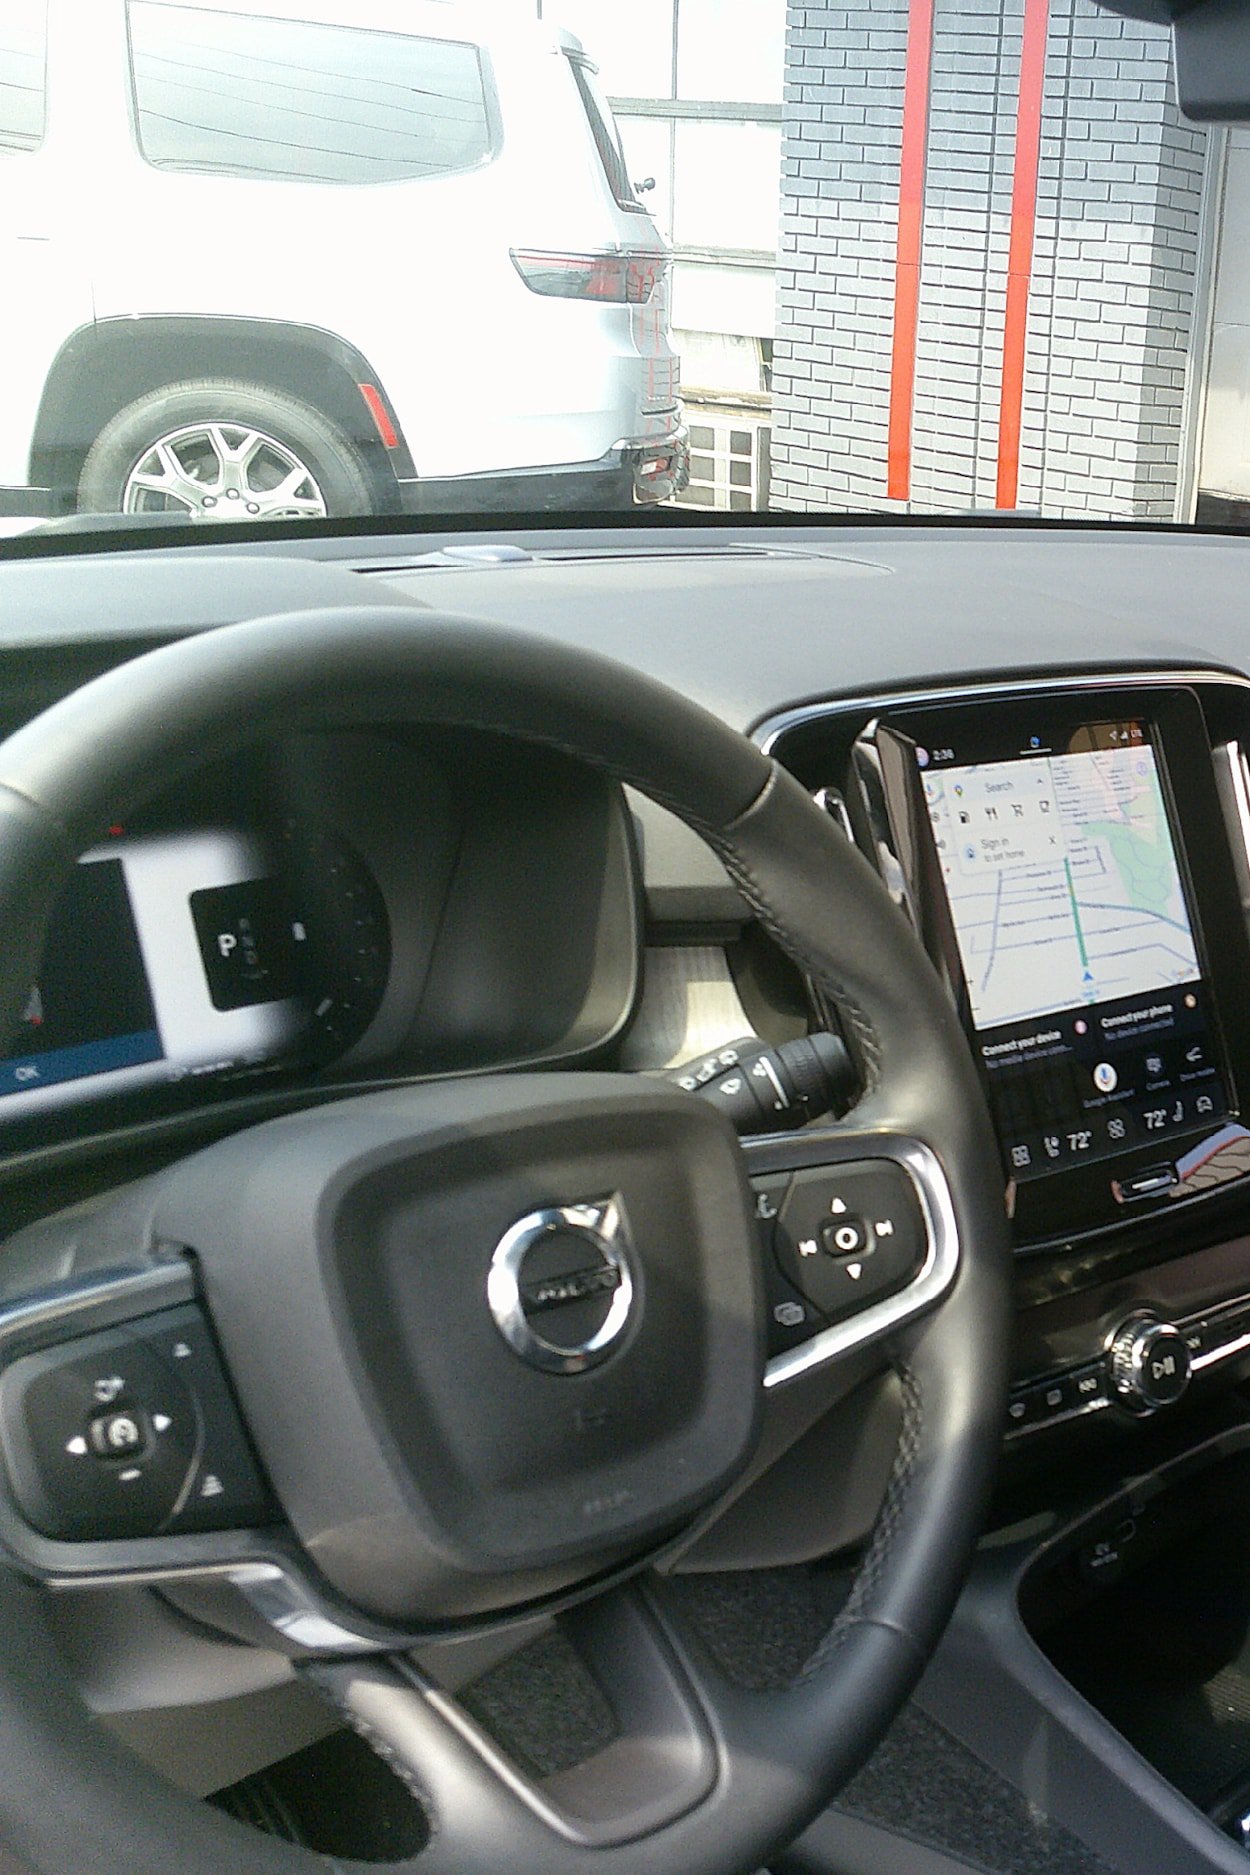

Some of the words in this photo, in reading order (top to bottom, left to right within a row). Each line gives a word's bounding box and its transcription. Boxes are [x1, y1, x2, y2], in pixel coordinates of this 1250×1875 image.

[985, 781, 1014, 793] Search
[981, 839, 999, 851] Sign
[217, 933, 238, 958] P
[1101, 1012, 1133, 1028] Connect
[1133, 1009, 1150, 1023] your
[1150, 1004, 1174, 1019] phone
[982, 1040, 1018, 1057] Connect
[1018, 1036, 1036, 1050] your
[1036, 1030, 1062, 1045] device
